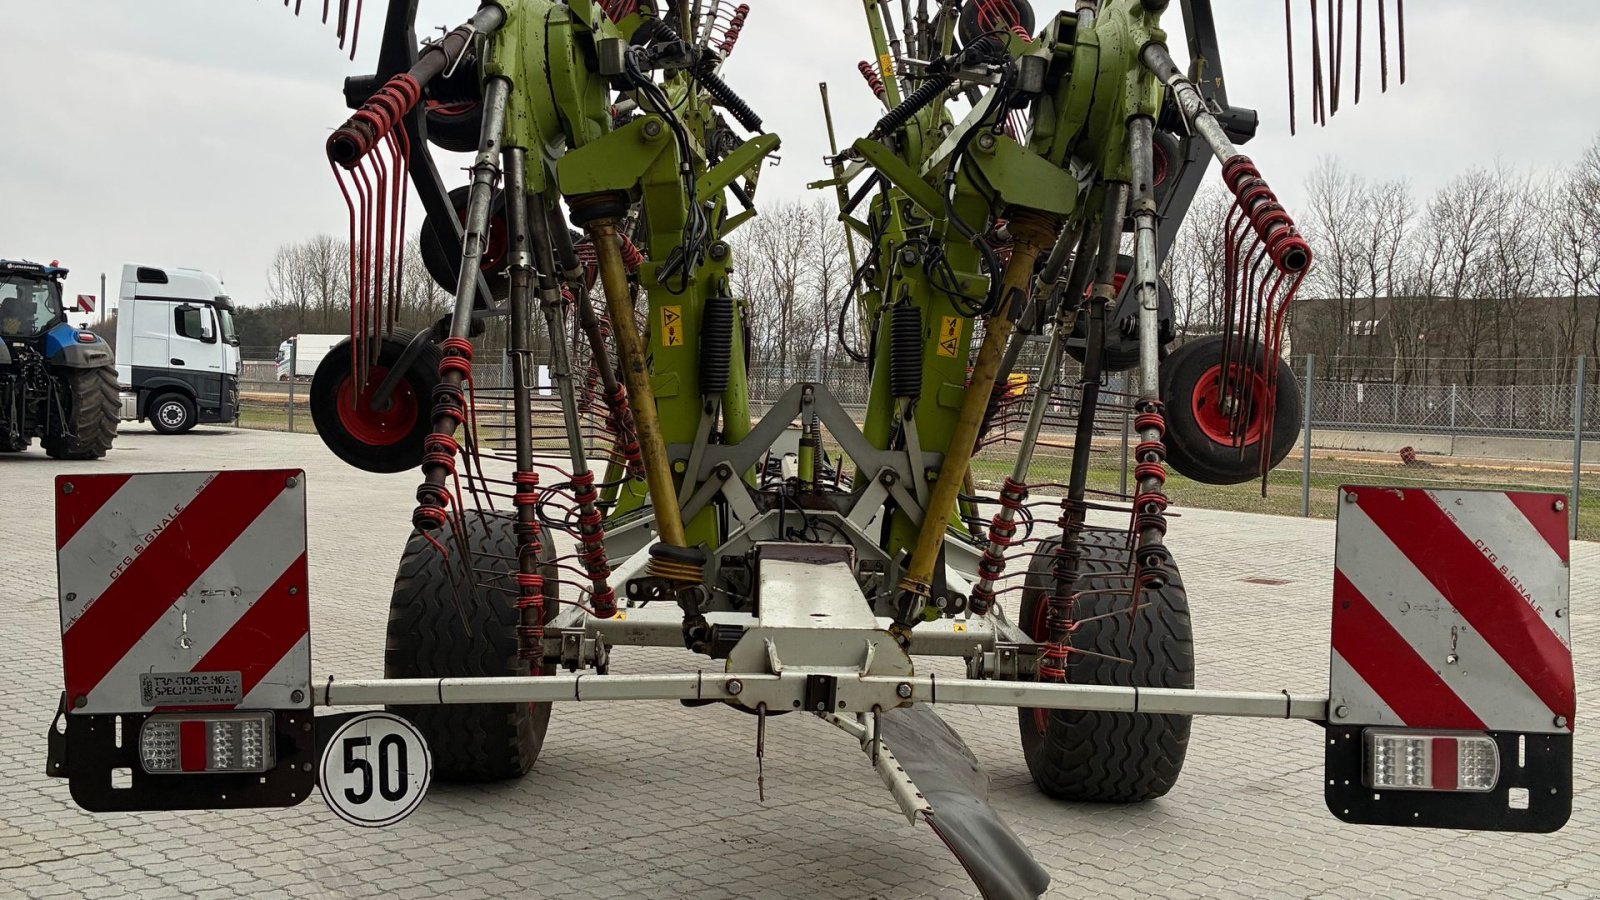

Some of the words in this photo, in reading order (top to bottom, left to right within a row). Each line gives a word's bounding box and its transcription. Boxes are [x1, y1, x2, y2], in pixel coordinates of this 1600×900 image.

[109, 555, 133, 580] CFG
[134, 503, 184, 554] SGNALE
[1474, 538, 1498, 564] CFG
[154, 676, 200, 686] TRATOR
[343, 733, 408, 804] 50
